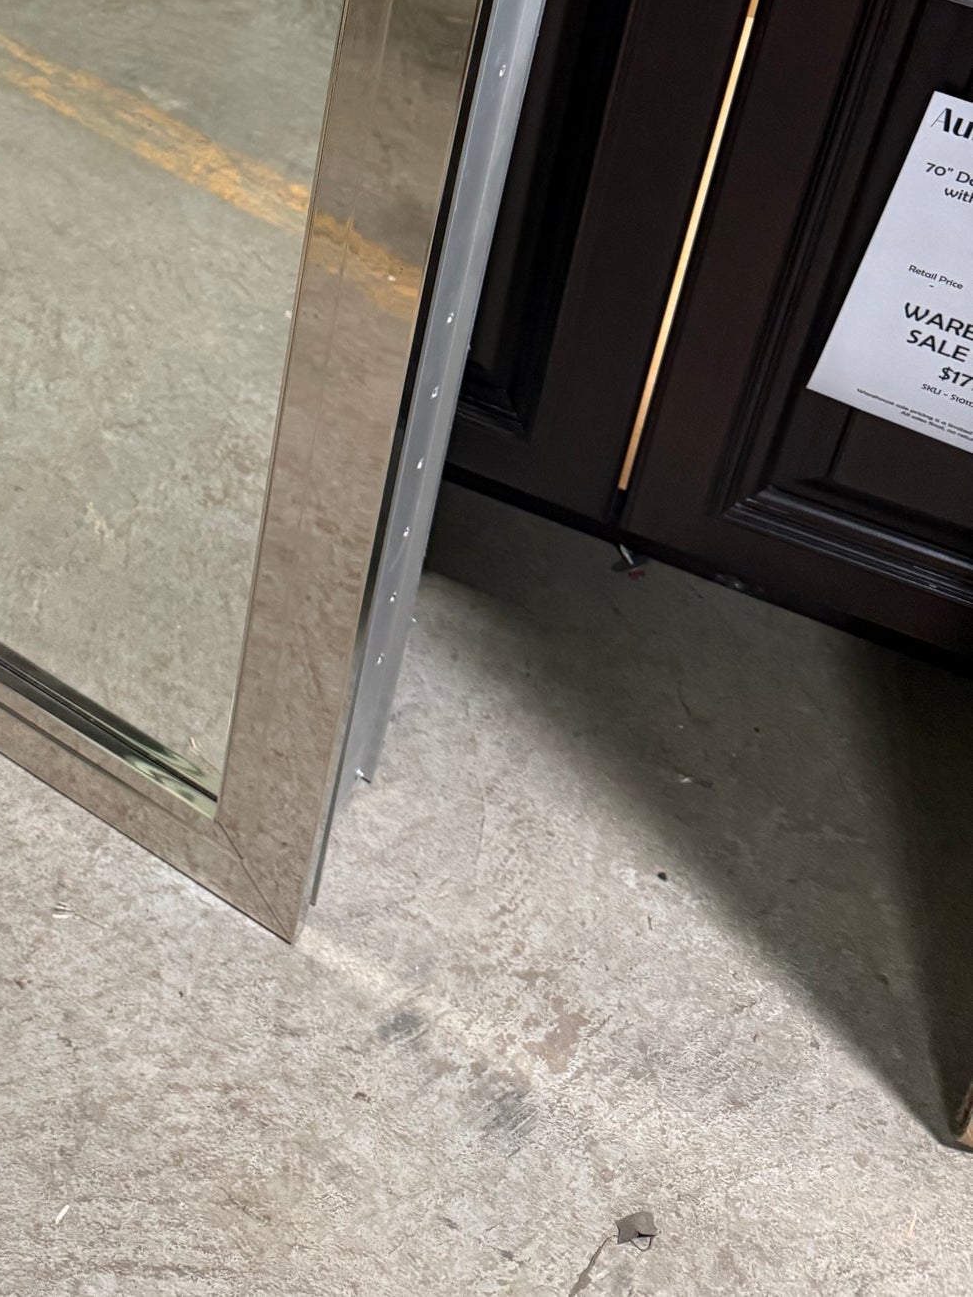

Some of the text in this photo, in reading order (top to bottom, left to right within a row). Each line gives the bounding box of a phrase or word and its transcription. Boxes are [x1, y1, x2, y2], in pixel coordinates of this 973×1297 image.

[930, 107, 973, 141] Au
[926, 162, 954, 178] 70"
[908, 264, 964, 290] Retail Price
[906, 329, 971, 363] SALE
[921, 383, 942, 396] SKU
[938, 366, 973, 392] $17
